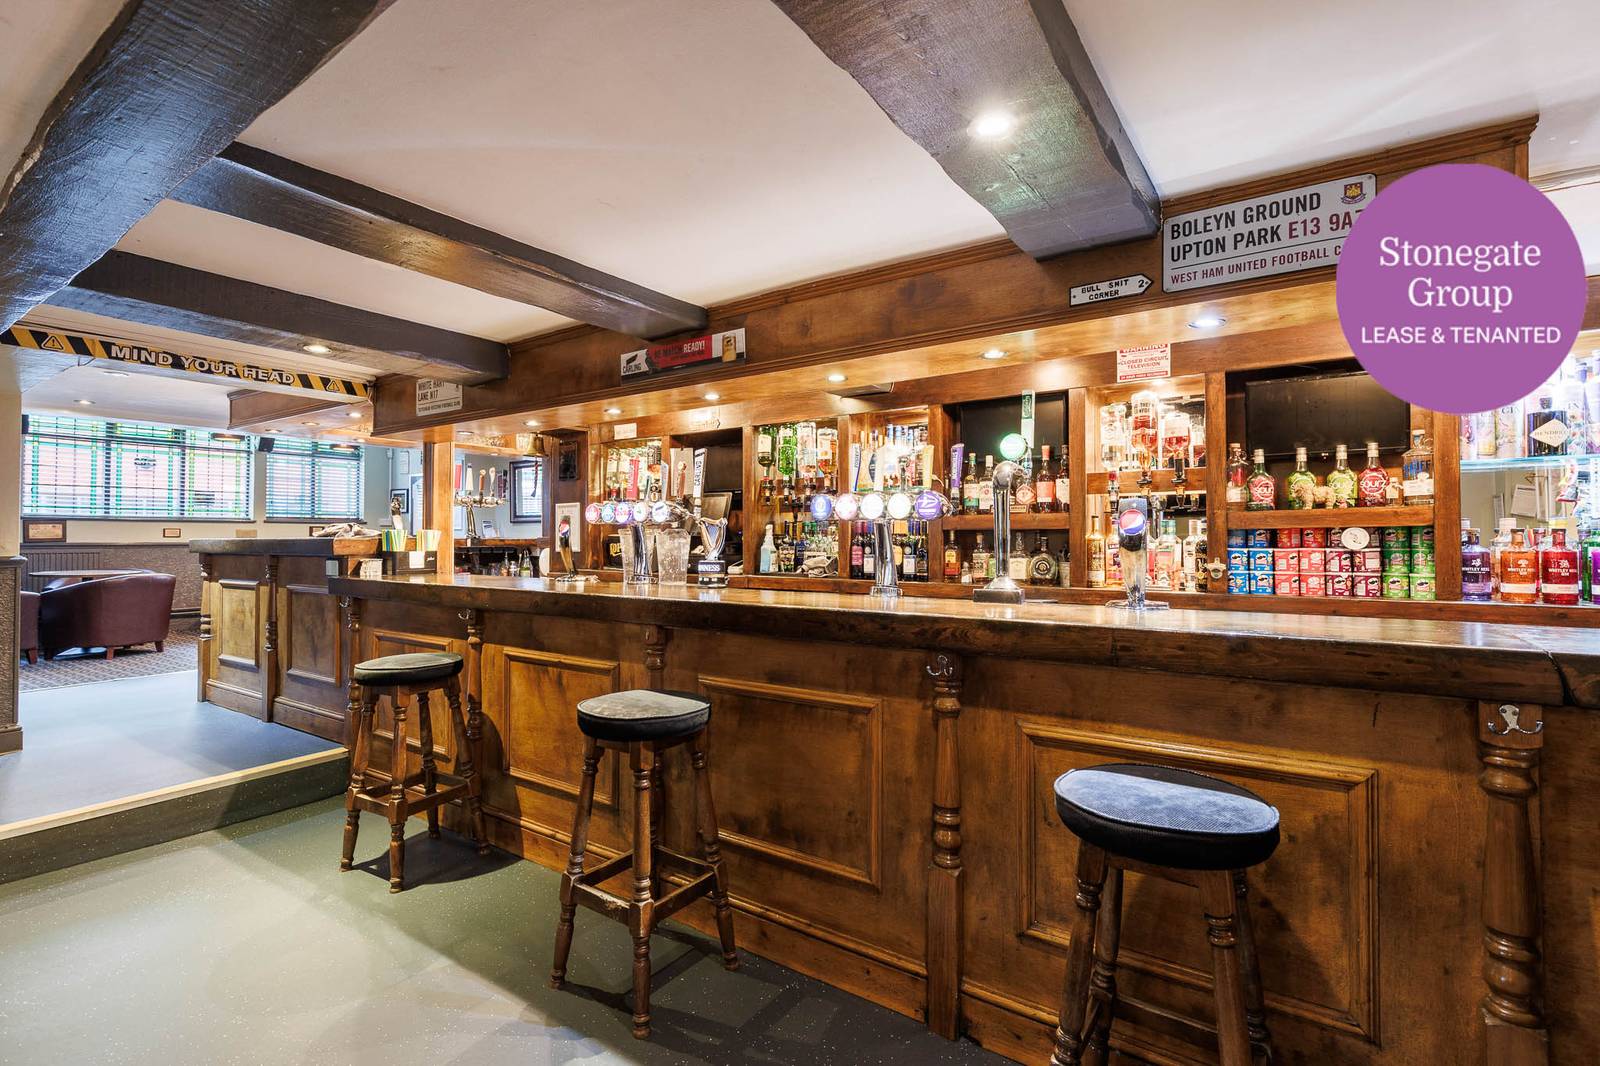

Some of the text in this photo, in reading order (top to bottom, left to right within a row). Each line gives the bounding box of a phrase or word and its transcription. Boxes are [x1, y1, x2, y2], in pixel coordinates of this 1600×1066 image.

[1171, 210, 1236, 240] BOLEYN
[1243, 192, 1321, 224] GROUND
[1171, 208, 1365, 262] UPTON PARK E13 9A
[1171, 270, 1198, 284] WEST
[1202, 265, 1224, 280] HAM
[1228, 258, 1267, 275] UNITED
[1272, 247, 1330, 267] FOOTBALL
[1081, 284, 1102, 294] BULL
[1137, 279, 1145, 288] 2
[1088, 289, 1119, 301] CORNER
[683, 340, 706, 354] READY!
[110, 344, 173, 366] MIND
[179, 355, 238, 377] YOUR
[1120, 358, 1143, 366] CLOSED
[1127, 361, 1161, 369] TELEVISION
[622, 363, 642, 374] CARLING
